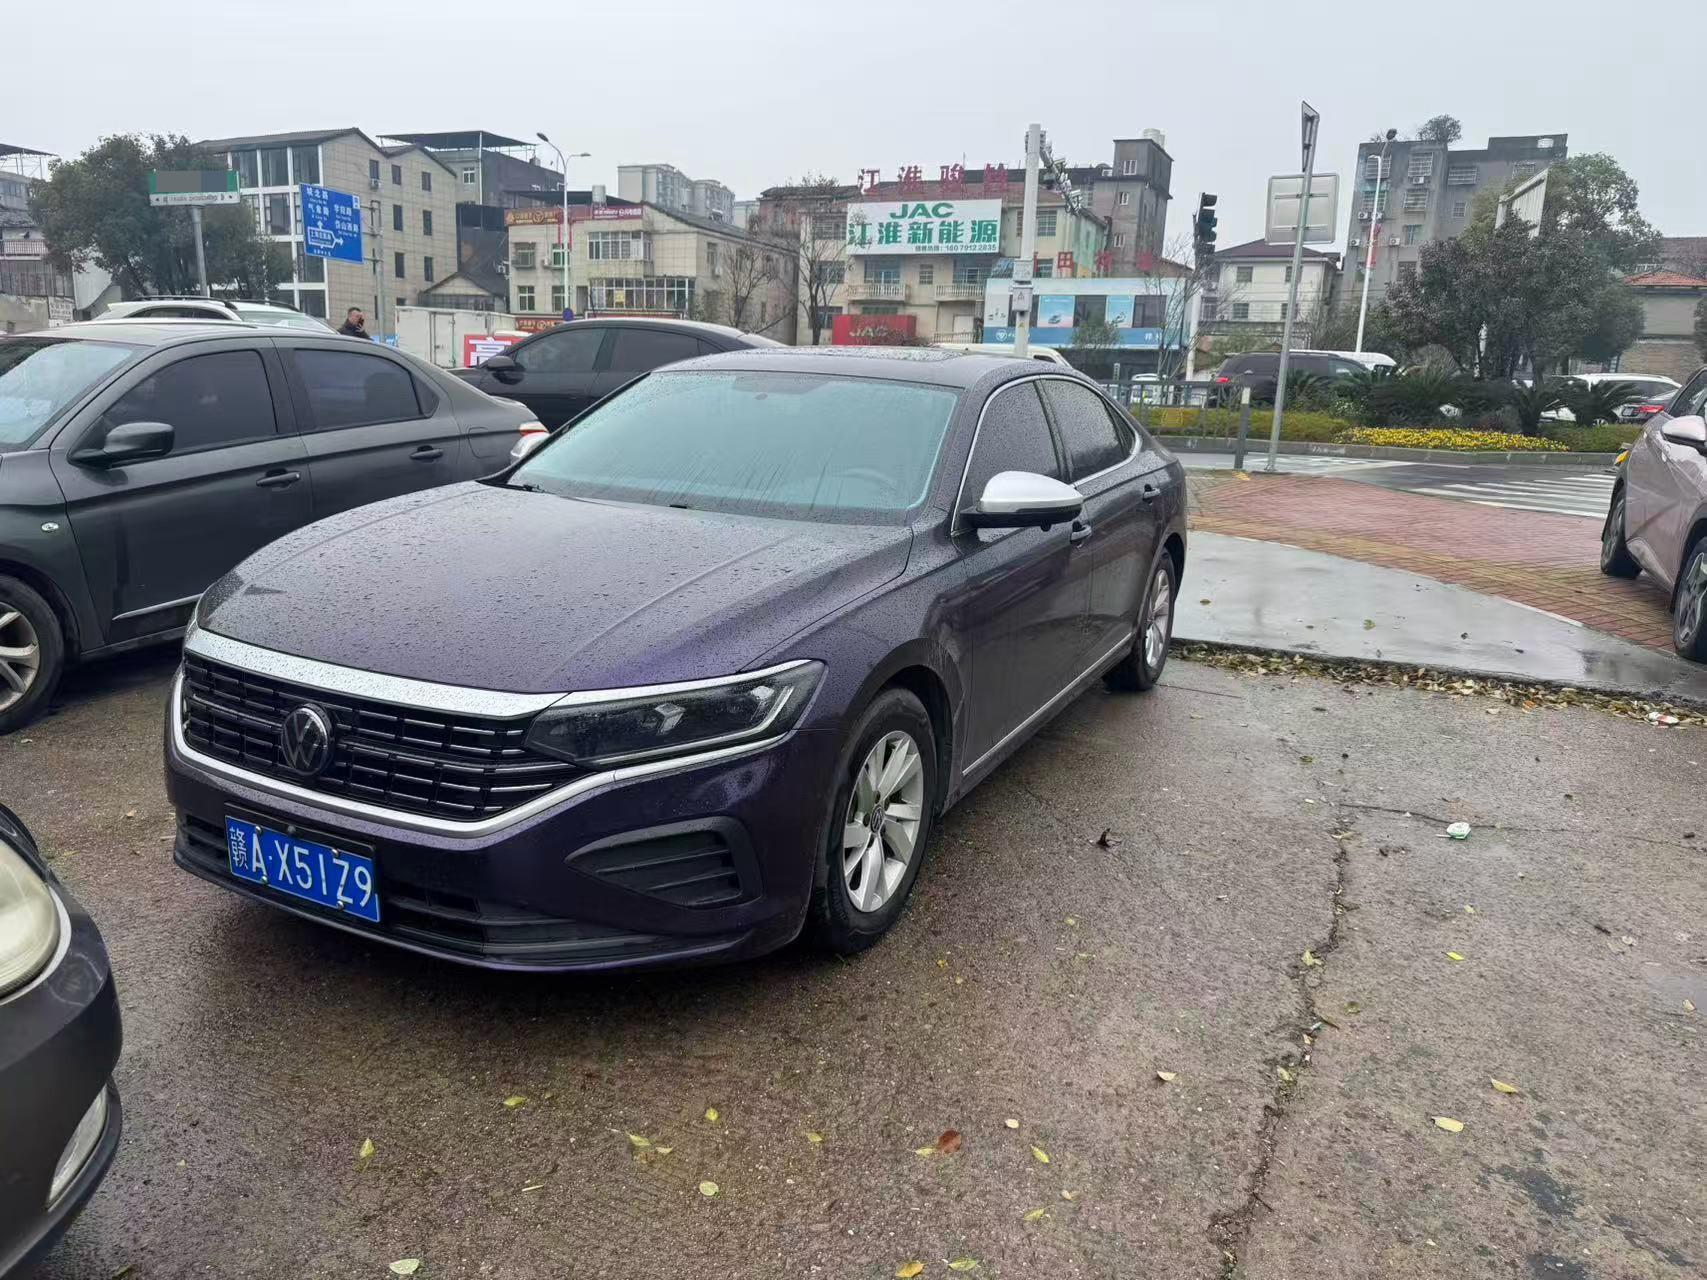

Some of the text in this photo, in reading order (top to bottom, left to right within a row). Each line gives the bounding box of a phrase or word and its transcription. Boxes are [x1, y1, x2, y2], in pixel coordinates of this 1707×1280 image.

[889, 202, 954, 219] JAC
[847, 219, 998, 246] 江淮新能源
